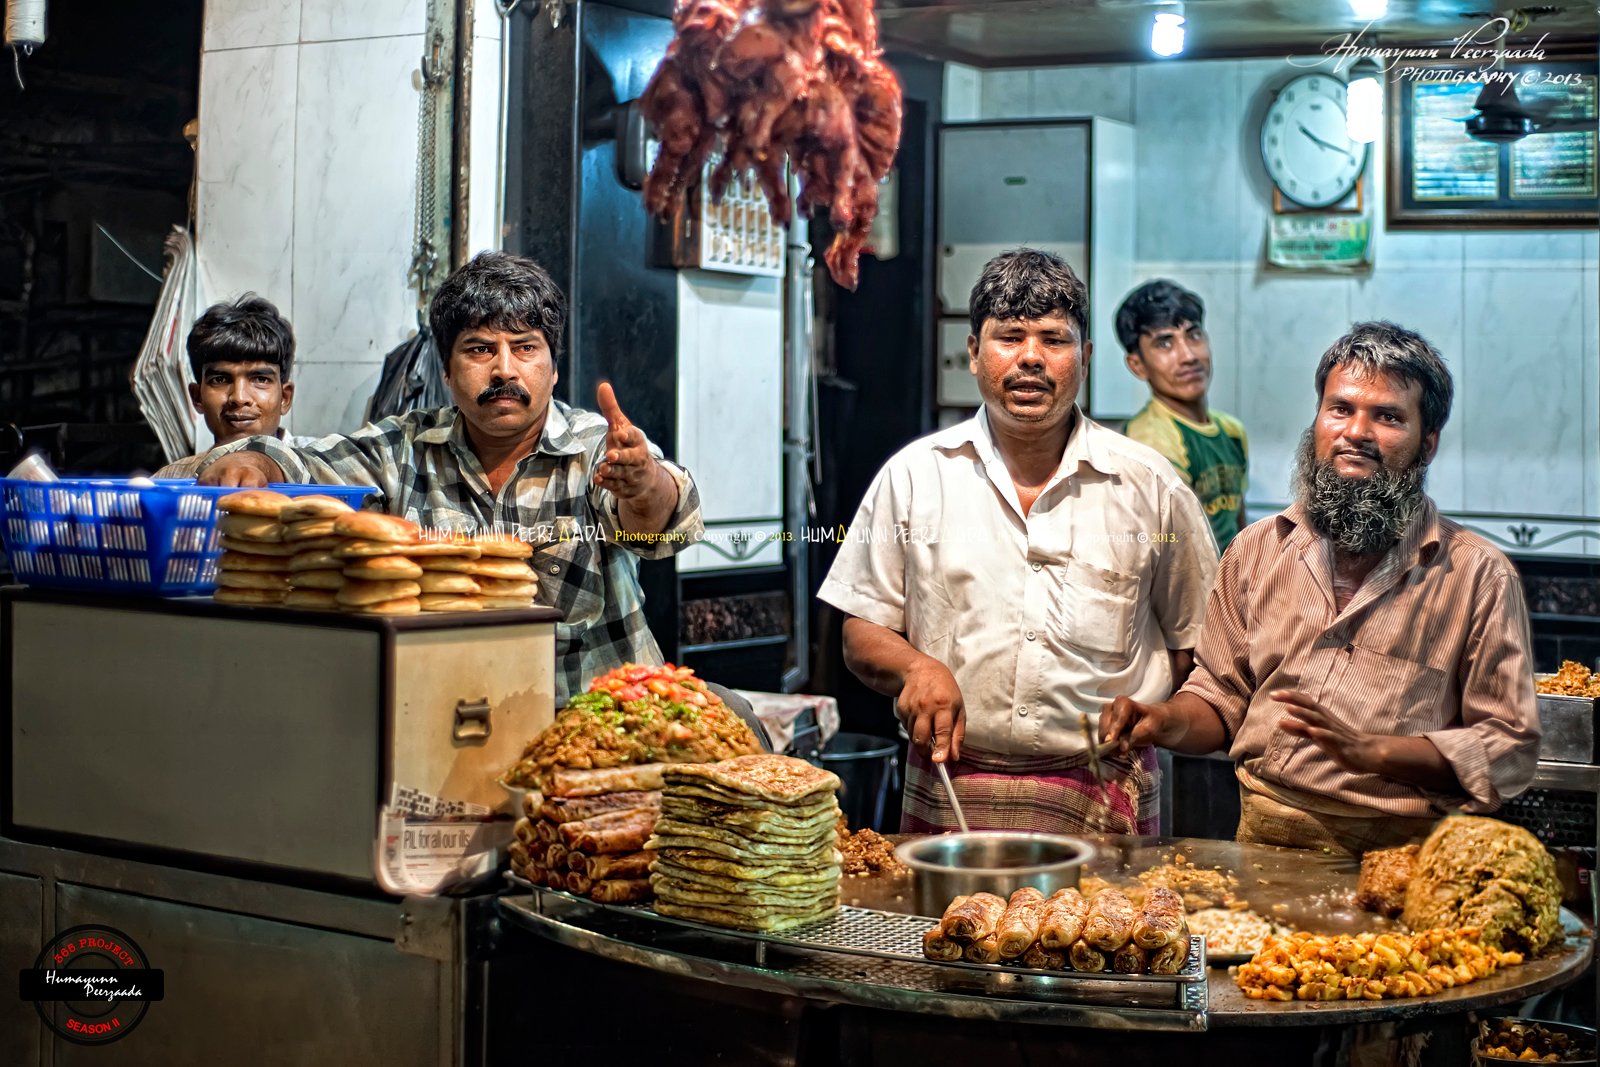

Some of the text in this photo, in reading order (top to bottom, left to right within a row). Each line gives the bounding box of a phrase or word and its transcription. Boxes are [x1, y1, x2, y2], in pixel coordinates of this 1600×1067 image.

[418, 830, 429, 849] for
[431, 830, 441, 849] all
[443, 832, 457, 849] our
